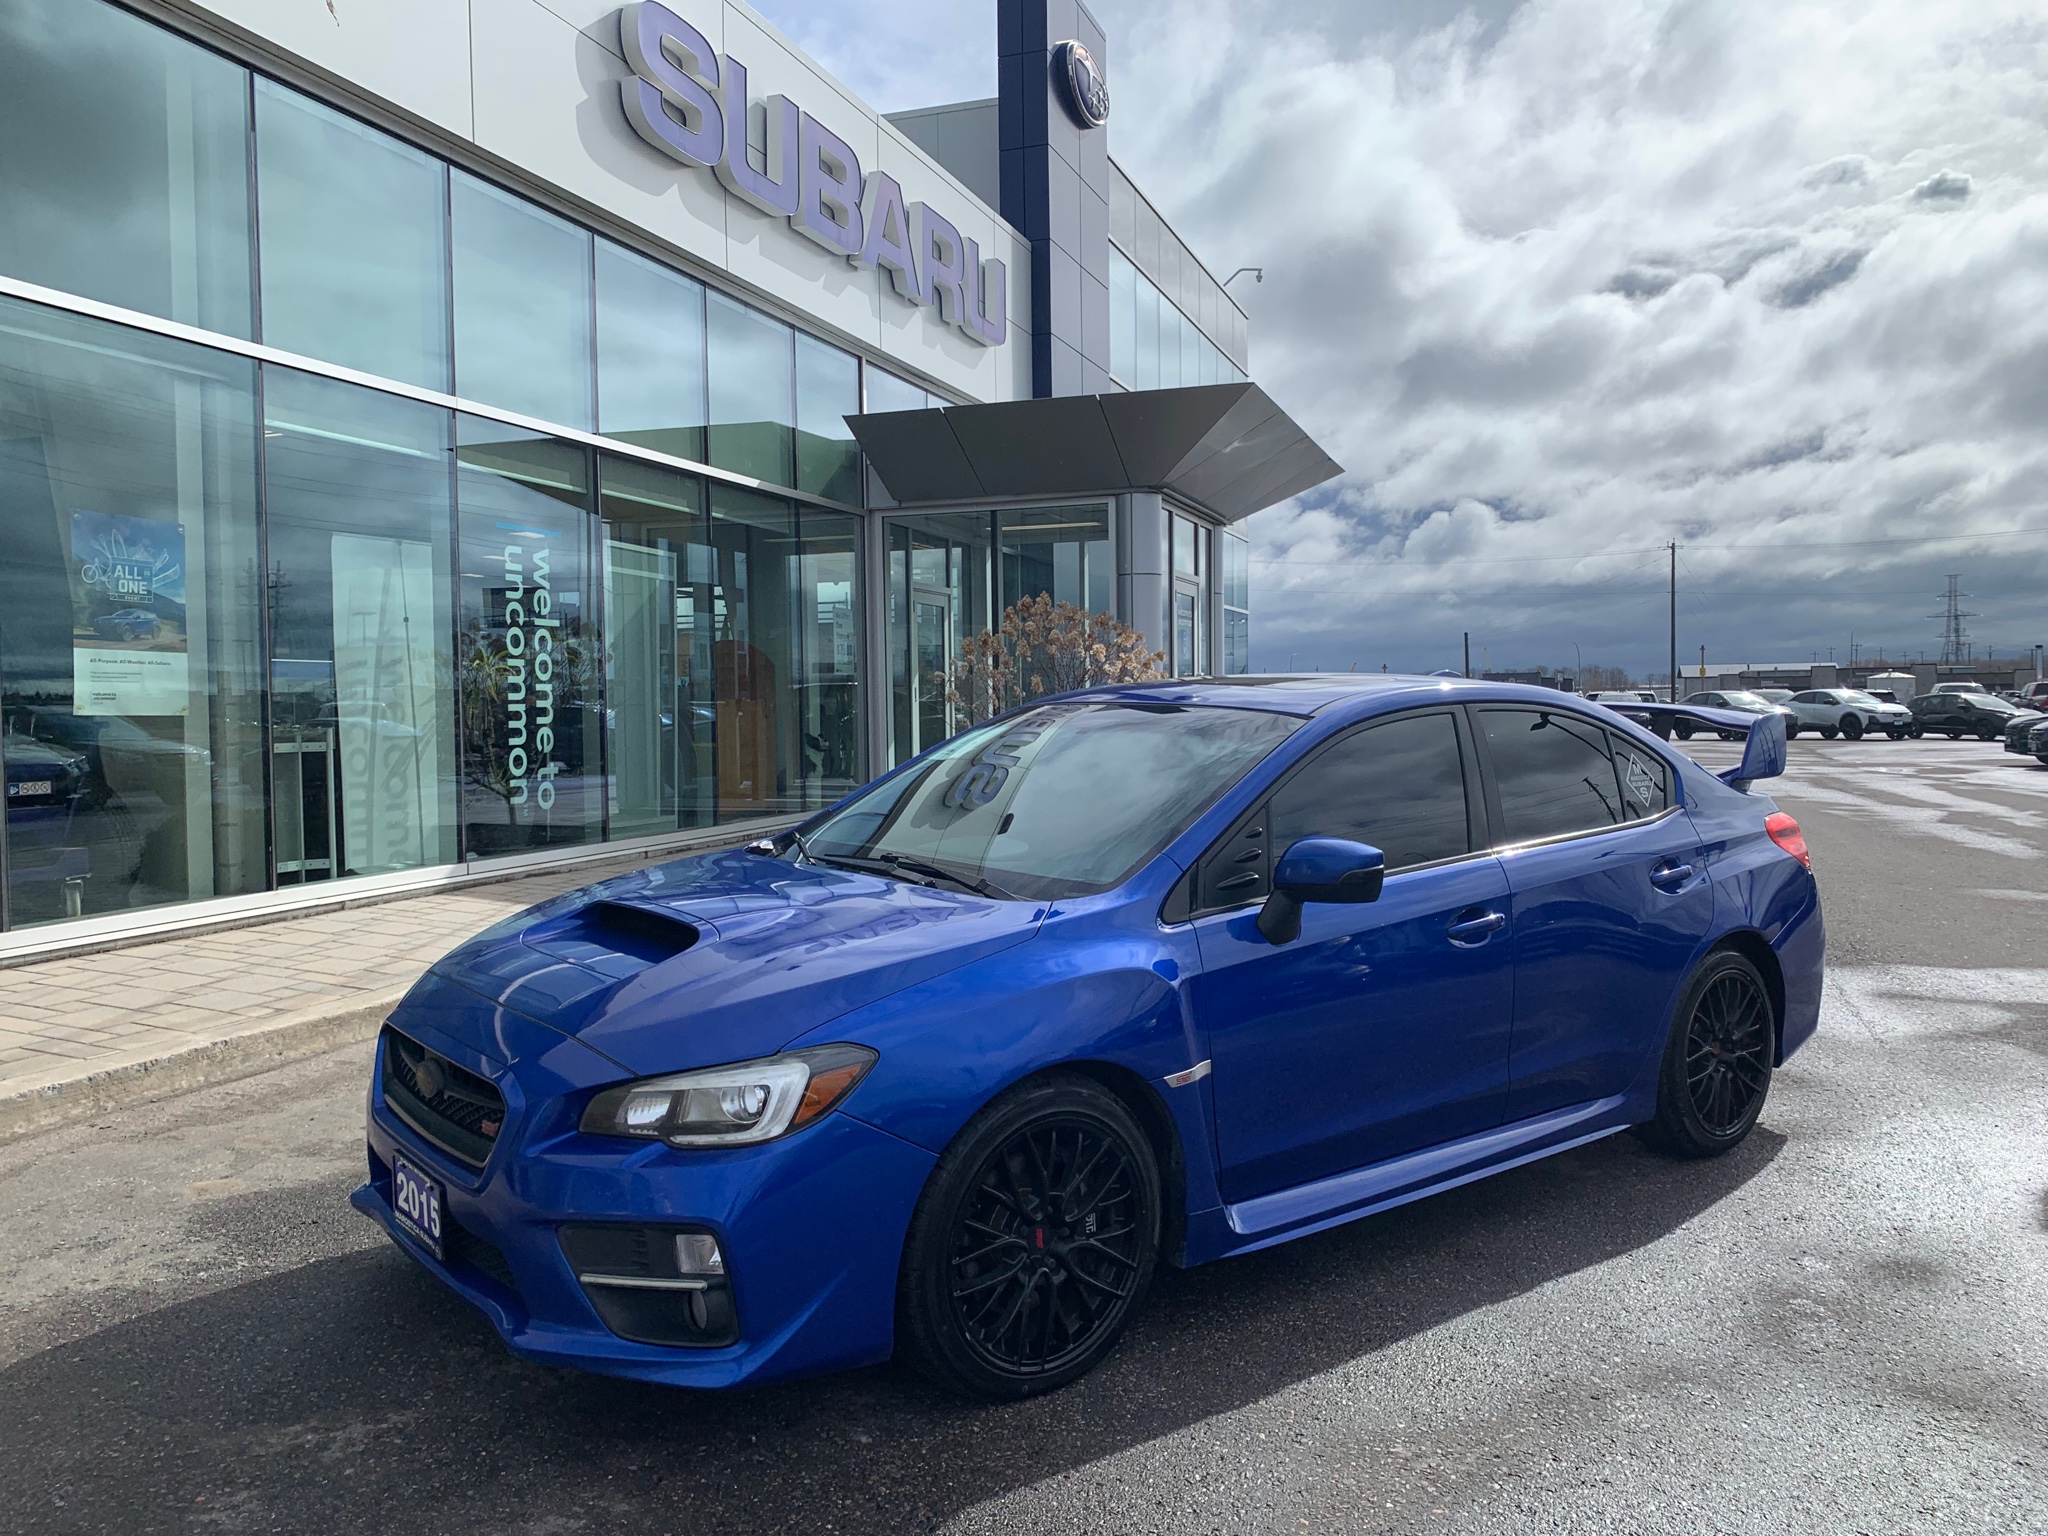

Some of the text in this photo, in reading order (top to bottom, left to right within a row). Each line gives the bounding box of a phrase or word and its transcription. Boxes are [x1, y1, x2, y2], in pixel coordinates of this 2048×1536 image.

[621, 0, 1006, 347] SUBARU
[114, 565, 143, 580] ALL
[118, 580, 148, 594] ONE
[505, 546, 529, 804] uncommon
[533, 549, 560, 810] welcome to
[1640, 787, 1649, 798] S
[397, 1172, 440, 1238] 2015
